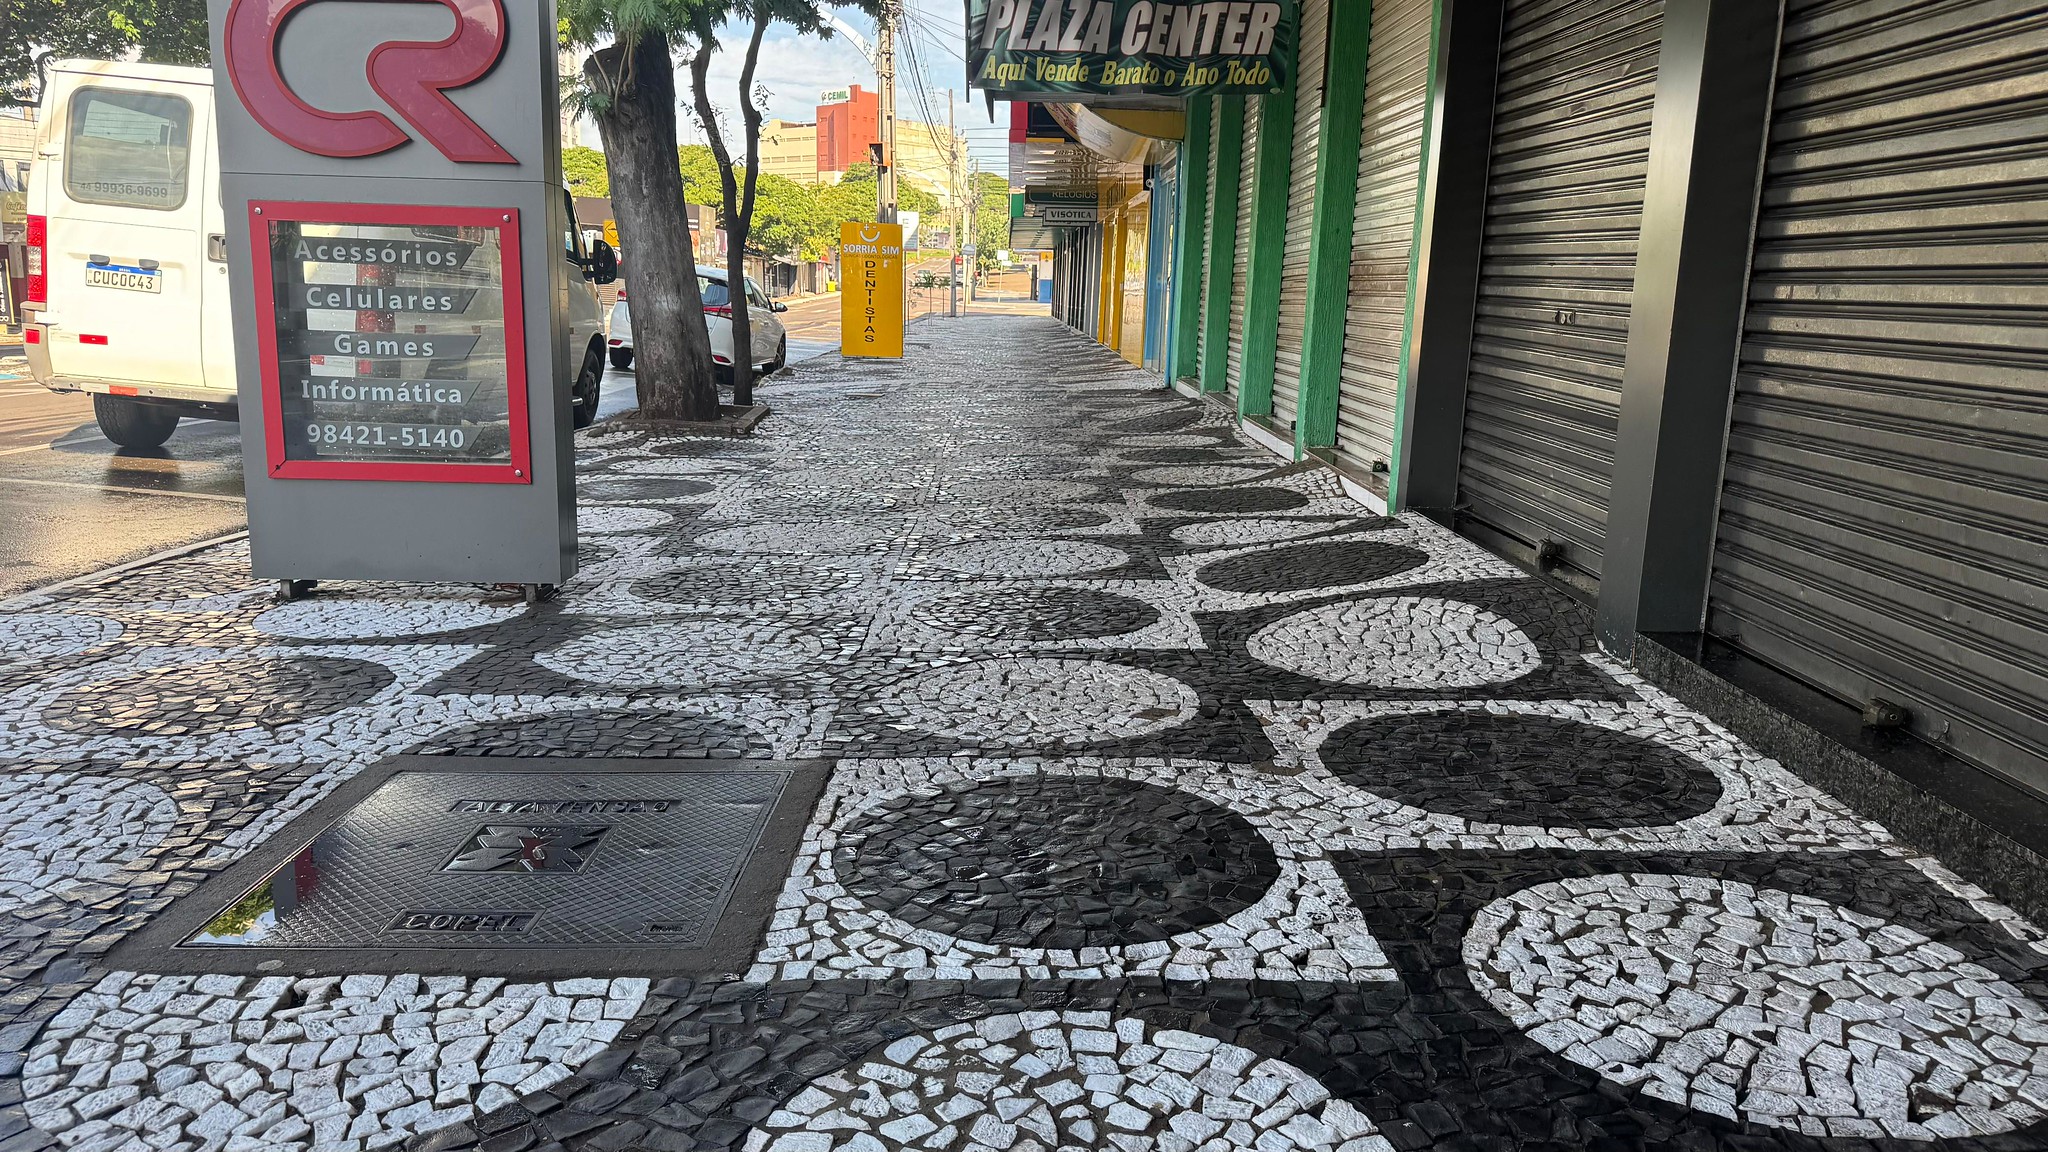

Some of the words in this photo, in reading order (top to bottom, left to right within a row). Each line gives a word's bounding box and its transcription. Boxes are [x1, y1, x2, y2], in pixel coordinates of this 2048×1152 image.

[979, 0, 1113, 55] PLAZA
[1120, 0, 1282, 57] CENTER
[982, 54, 1028, 88] Aqui
[1035, 56, 1090, 83] Vende
[1100, 60, 1160, 85] Barato
[1163, 69, 1176, 87] o
[1181, 62, 1219, 87] Ano
[1226, 60, 1271, 86] Todo
[827, 90, 849, 101] CEMIL
[94, 181, 168, 198] 99936-9699
[294, 239, 458, 267] Acessórios
[843, 243, 878, 254] SORRIA
[881, 245, 900, 255] SIM
[306, 286, 453, 311] Celulares
[864, 260, 877, 343] DENTISTAS
[333, 333, 435, 357] Games
[301, 379, 463, 404] Informática
[306, 423, 465, 449] 98421-5140
[402, 912, 525, 932] COPEL
